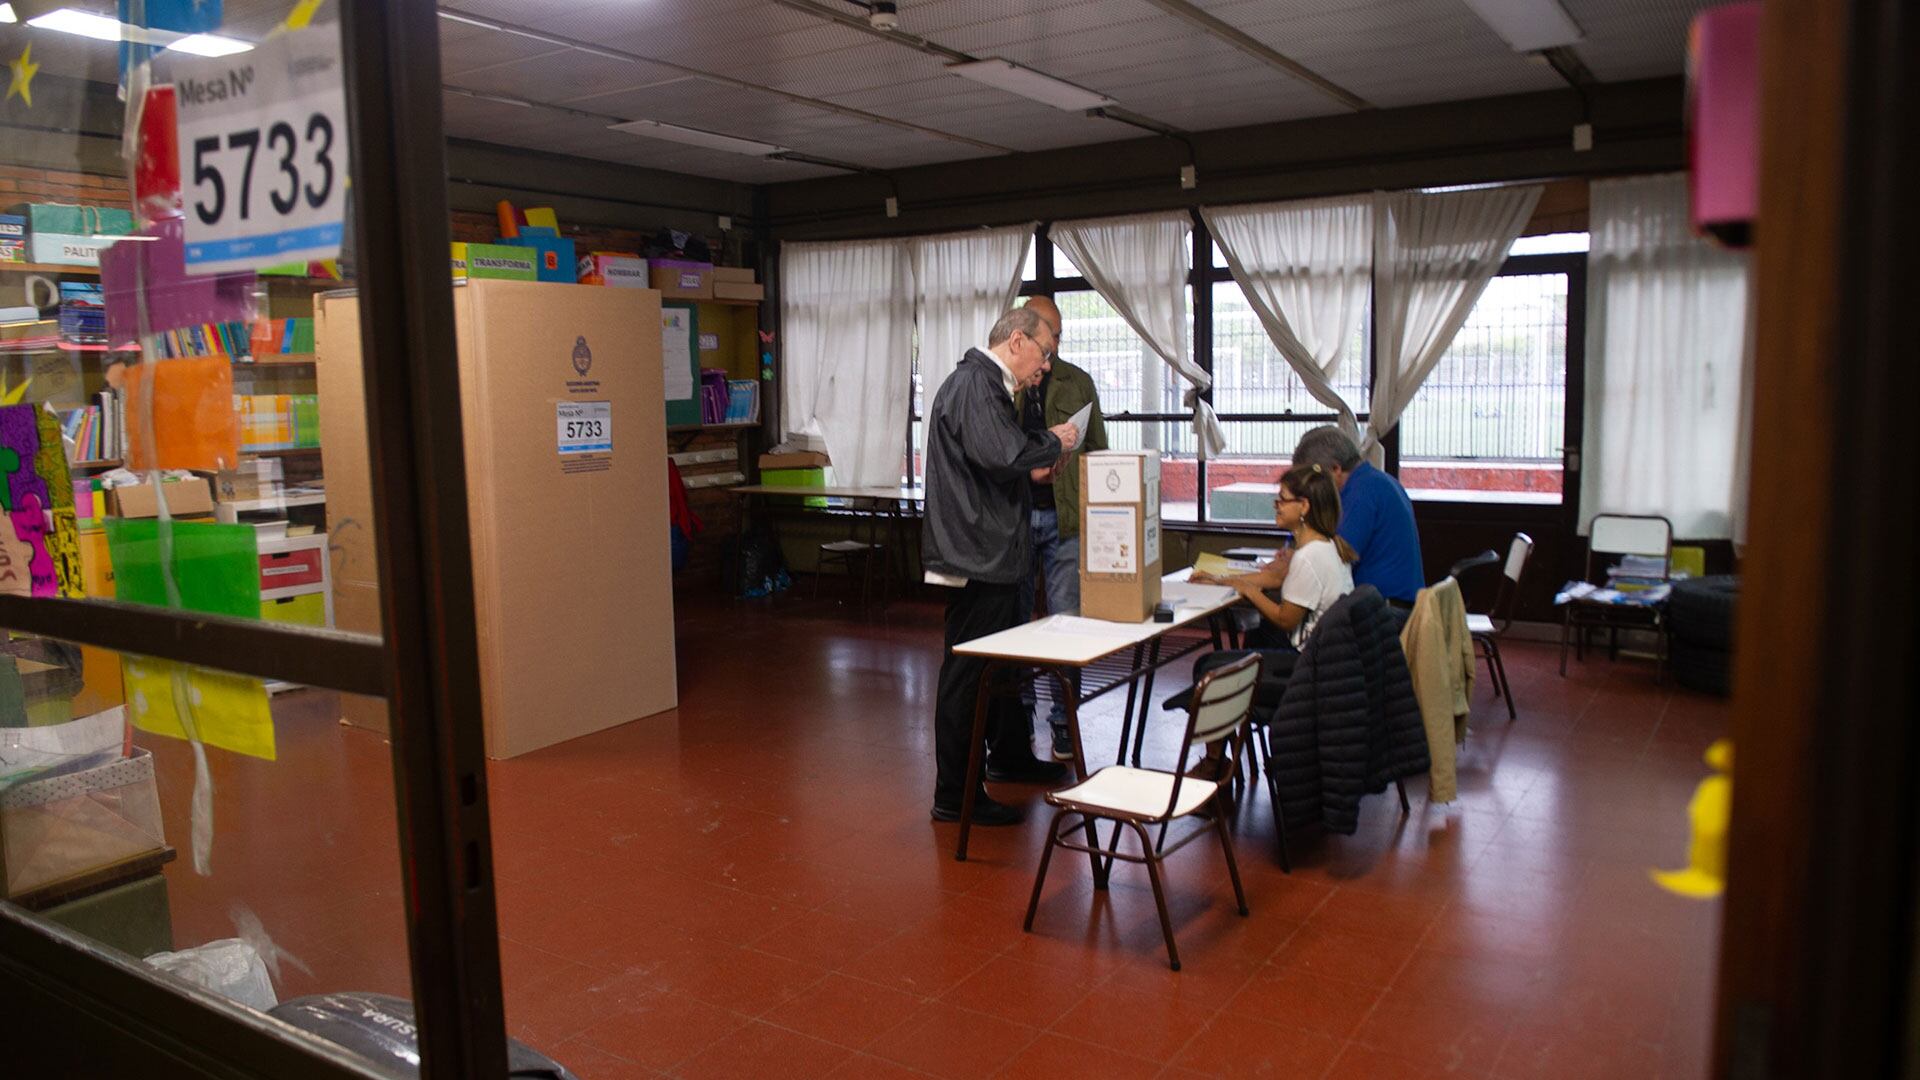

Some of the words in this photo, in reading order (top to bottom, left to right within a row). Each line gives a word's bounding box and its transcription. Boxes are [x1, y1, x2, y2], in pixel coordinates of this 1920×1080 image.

[179, 78, 227, 107] Mesa
[194, 112, 333, 225] 5733
[474, 258, 531, 270] TRANSFORMA
[607, 267, 640, 278] NOMBRAR
[559, 409, 574, 417] Mesa
[566, 420, 603, 438] 5733
[362, 1009, 417, 1040] SURA
